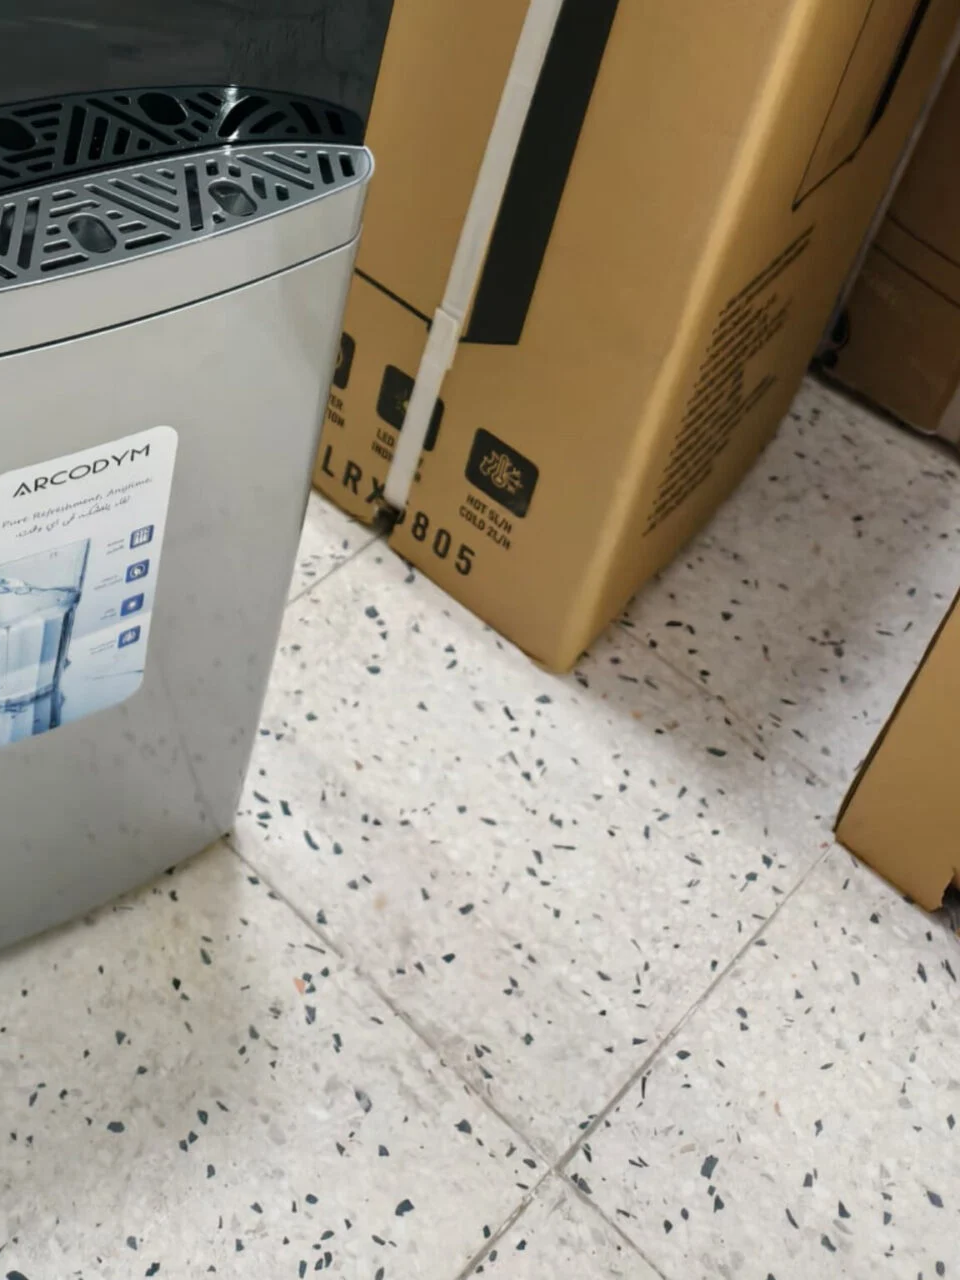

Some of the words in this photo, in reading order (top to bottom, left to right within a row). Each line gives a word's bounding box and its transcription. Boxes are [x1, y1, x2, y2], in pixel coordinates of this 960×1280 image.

[12, 443, 151, 499] ARCODYM
[466, 494, 488, 514] HOT
[459, 505, 486, 531] COLD
